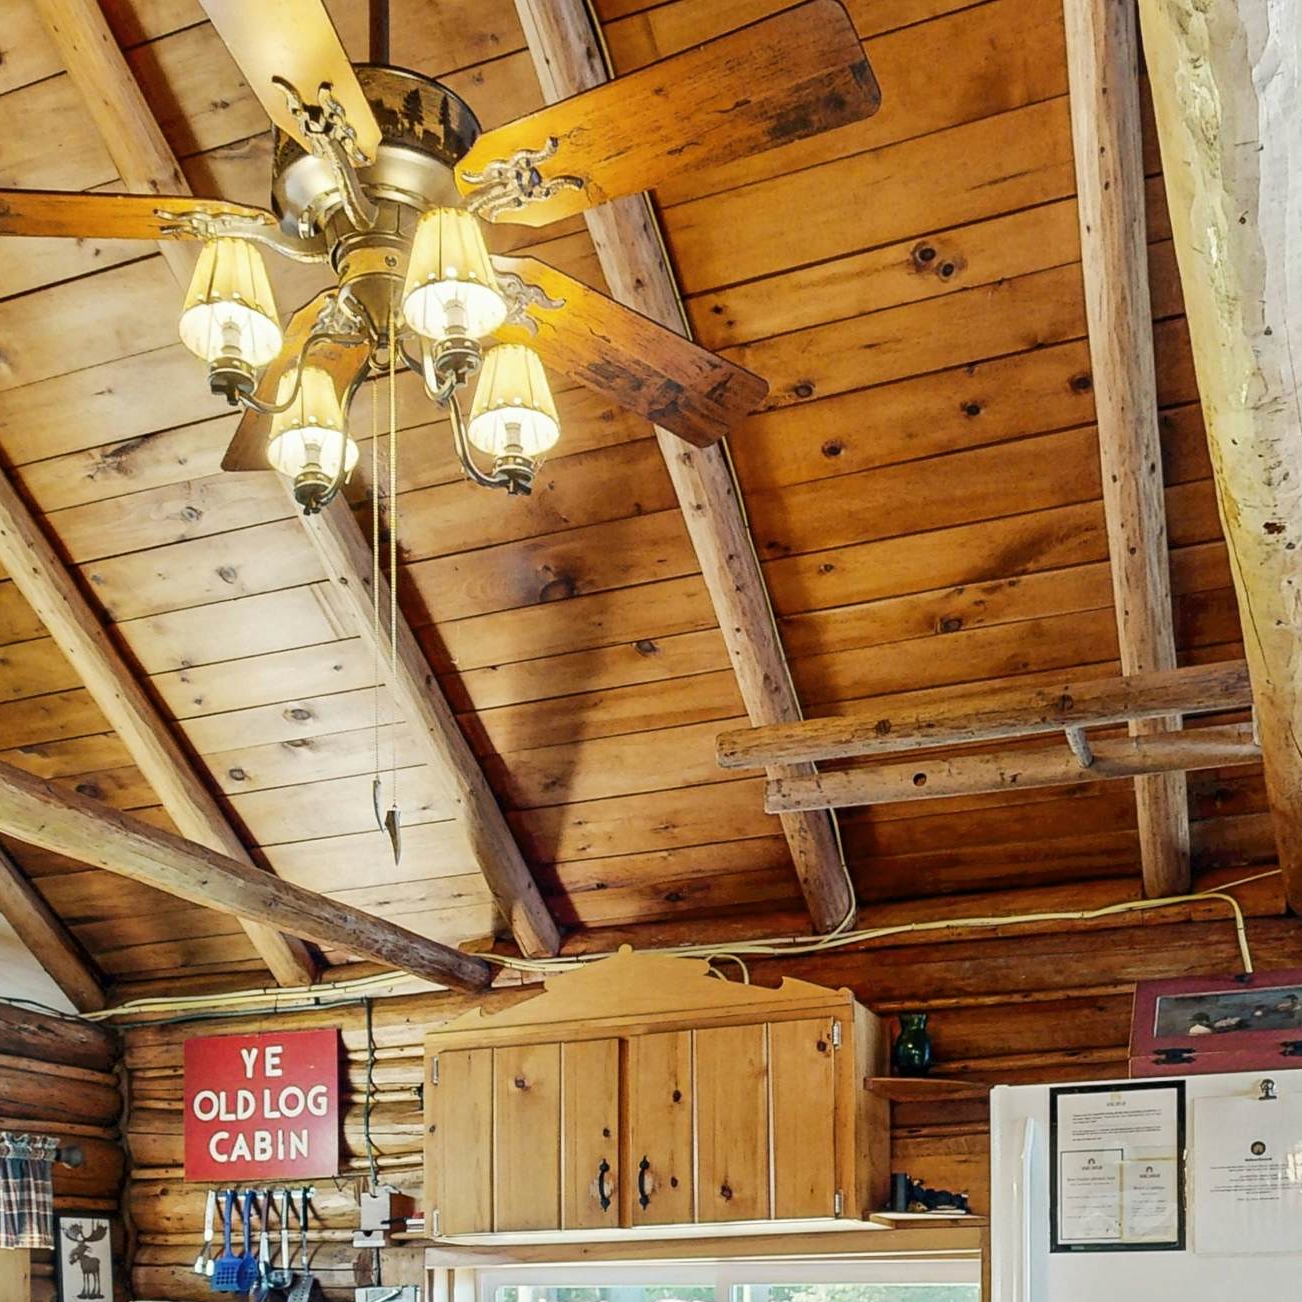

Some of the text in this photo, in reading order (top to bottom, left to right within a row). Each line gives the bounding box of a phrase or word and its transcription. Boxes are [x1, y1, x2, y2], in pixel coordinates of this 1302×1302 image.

[240, 1045, 283, 1078] YE
[193, 1084, 328, 1122] OLD LOG
[208, 1128, 309, 1163] CABIN
